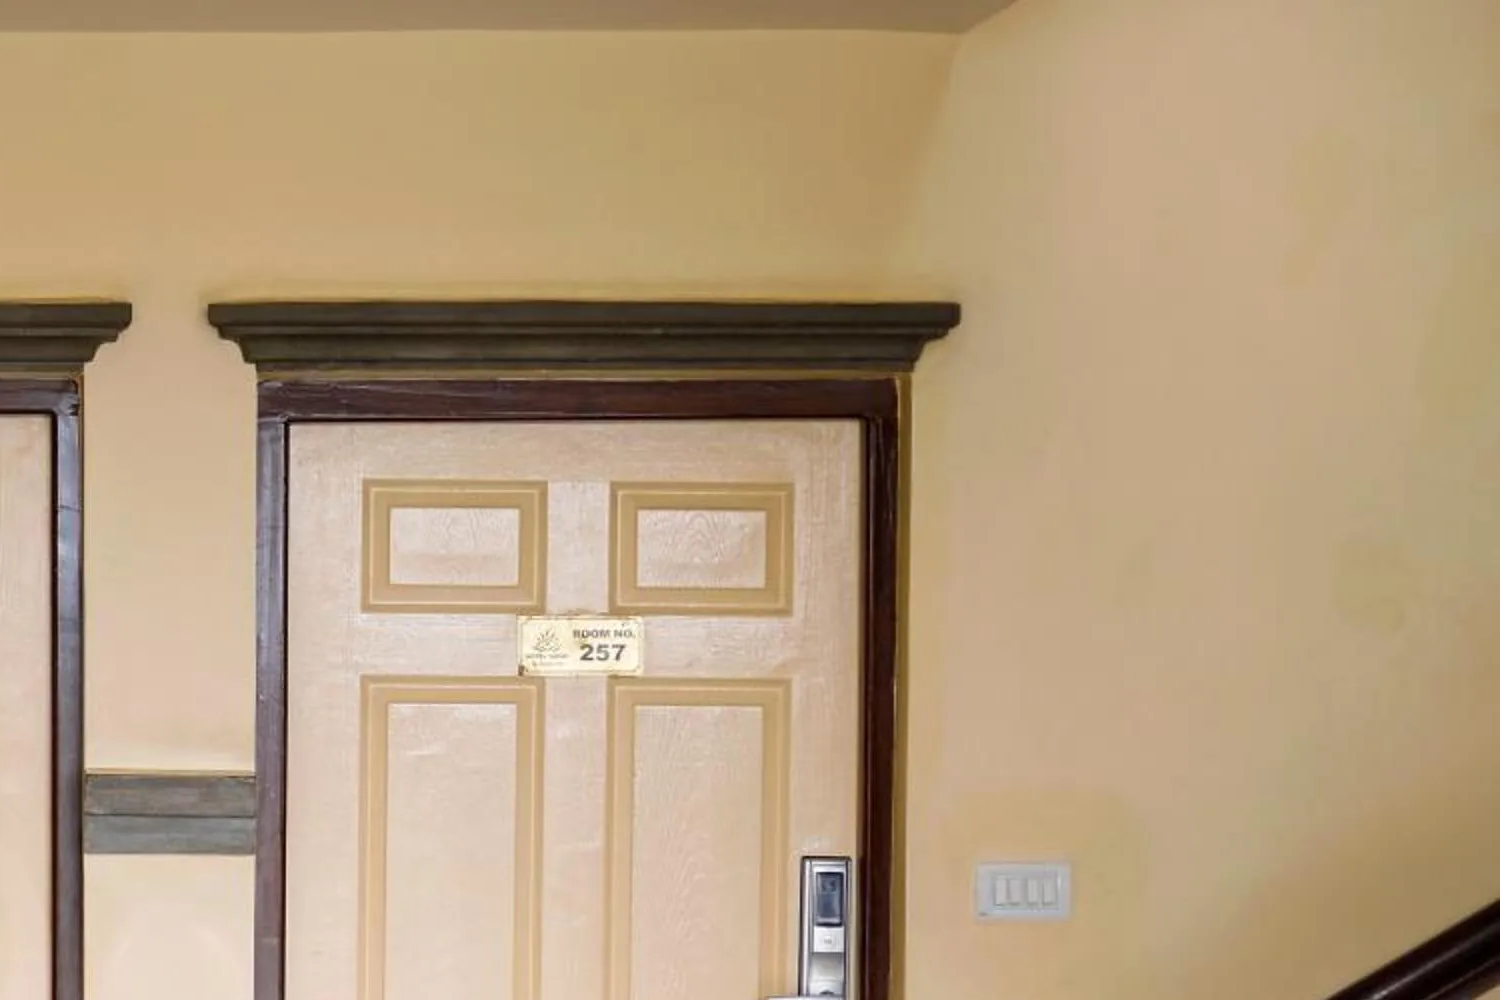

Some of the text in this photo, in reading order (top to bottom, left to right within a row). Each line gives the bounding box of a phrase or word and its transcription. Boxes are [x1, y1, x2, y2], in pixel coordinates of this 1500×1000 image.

[573, 629, 636, 638] ROOM NO.
[580, 644, 626, 661] 257
